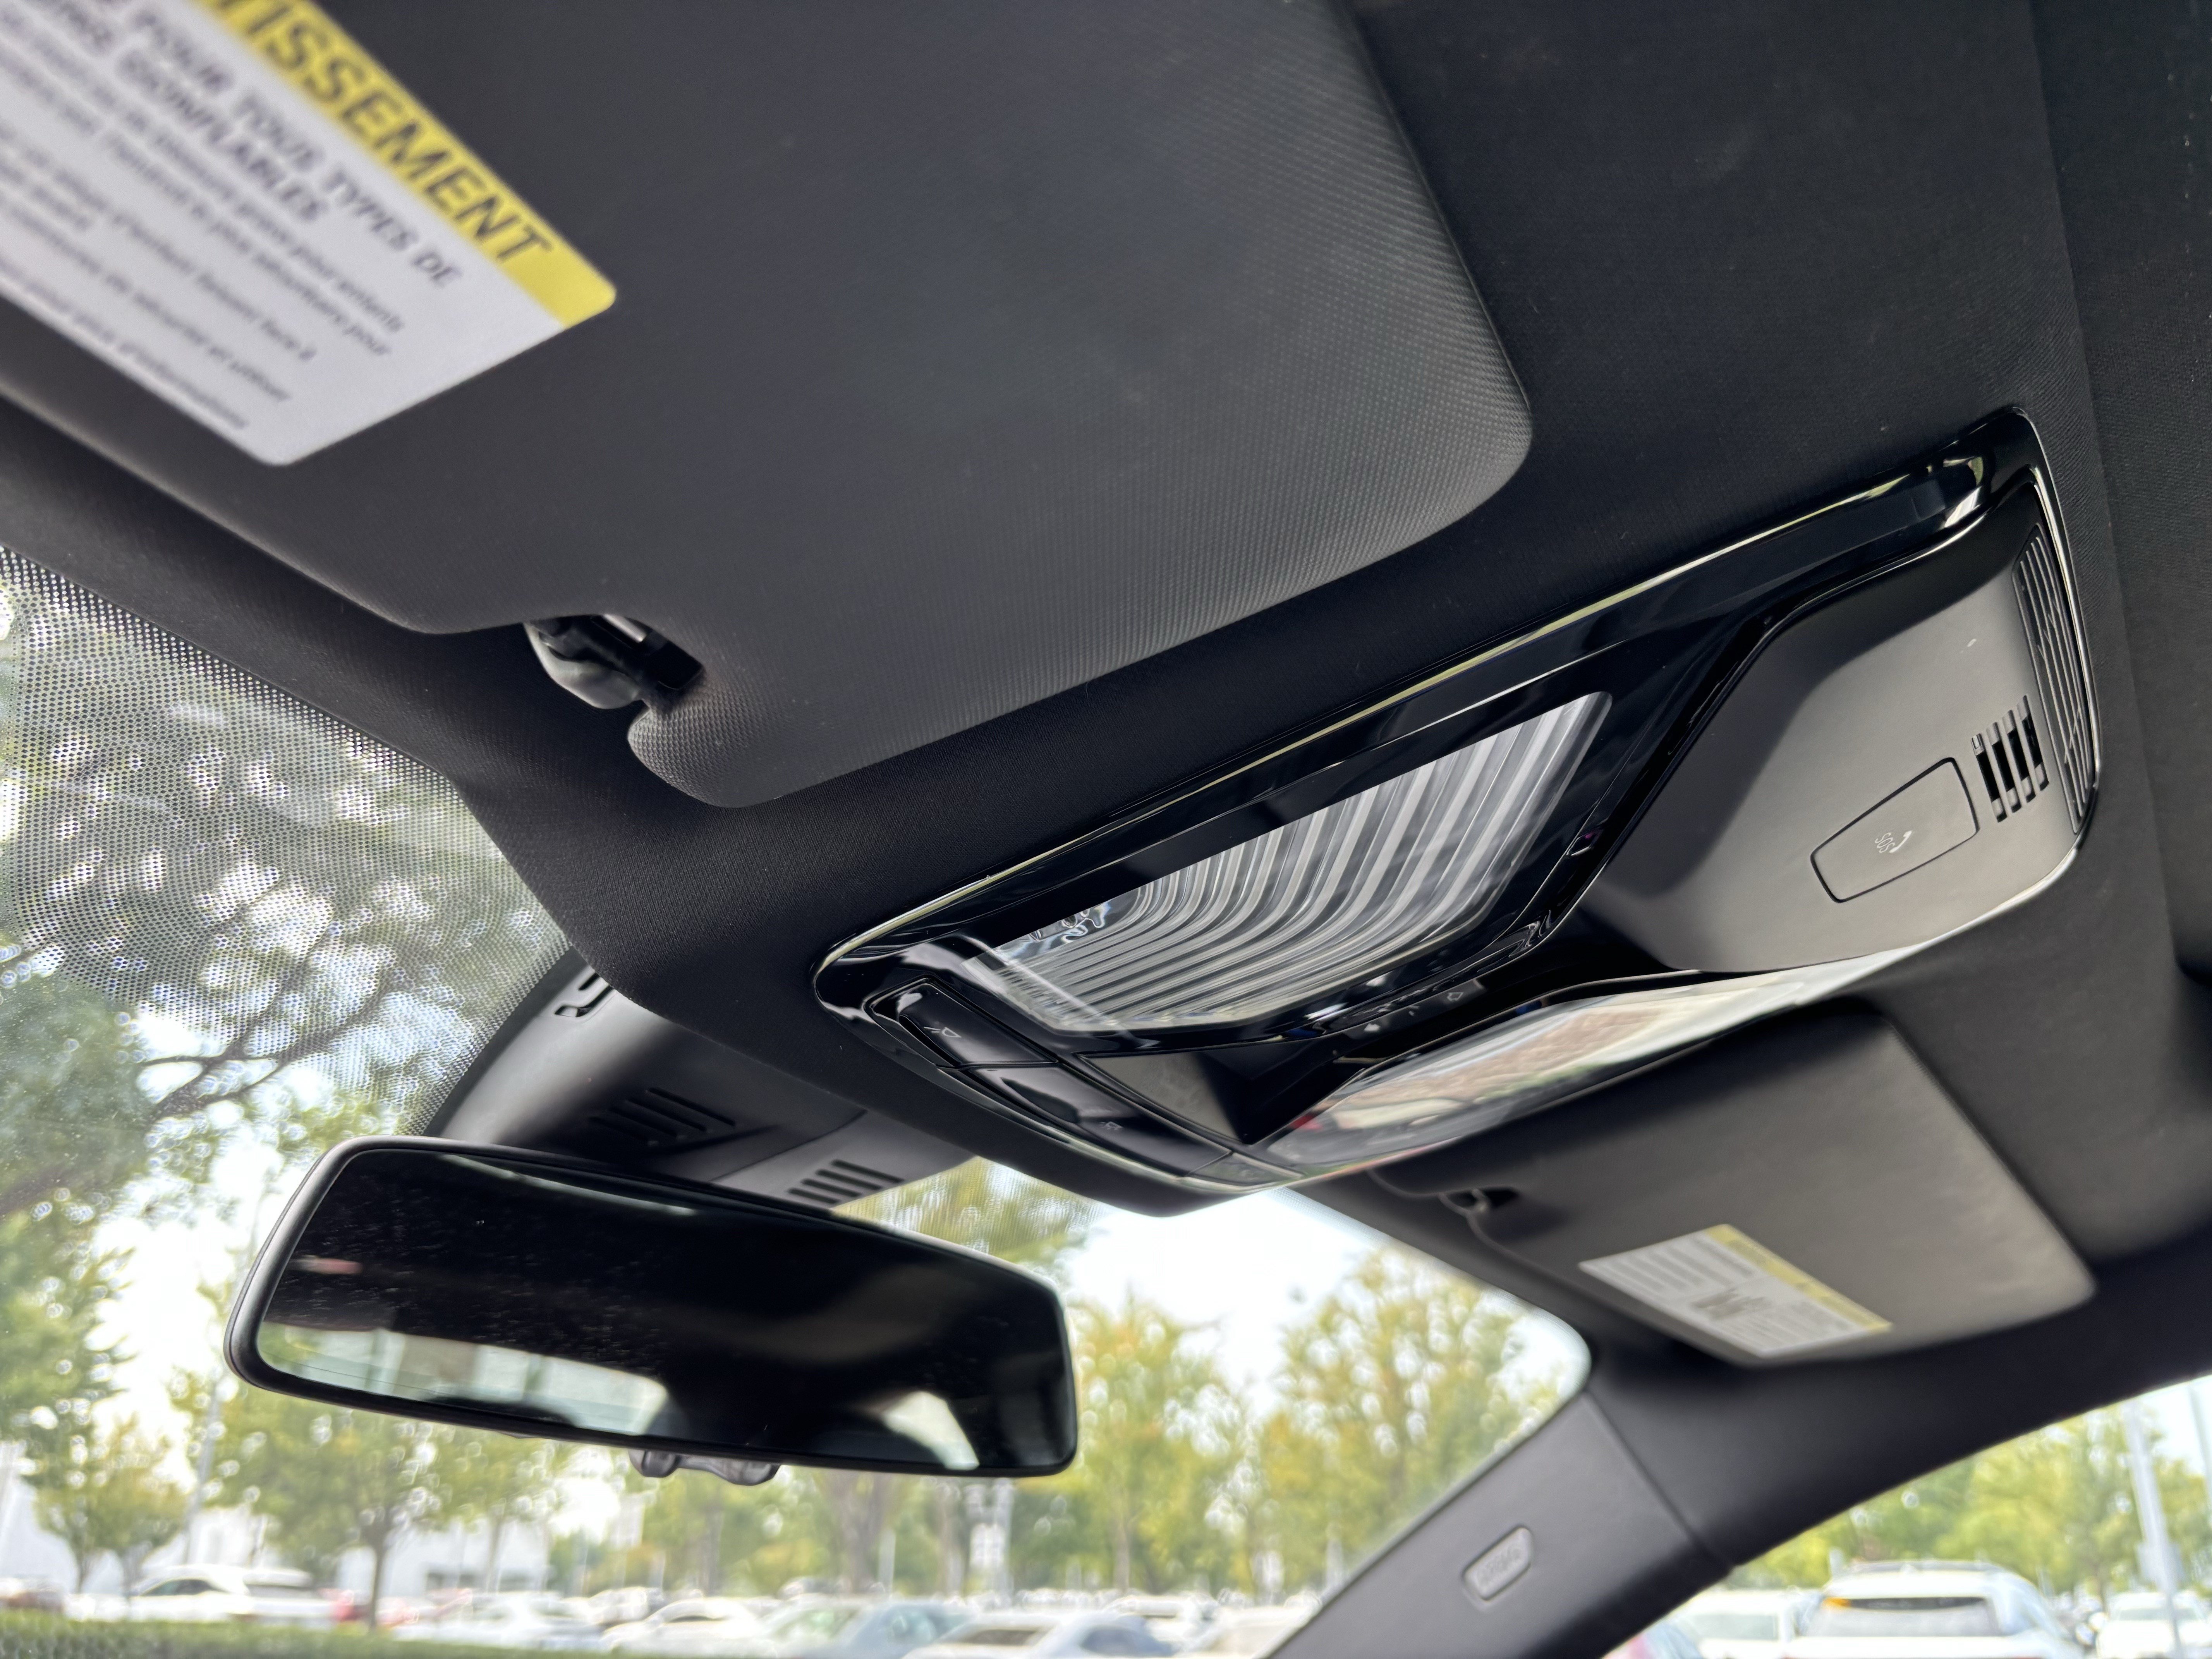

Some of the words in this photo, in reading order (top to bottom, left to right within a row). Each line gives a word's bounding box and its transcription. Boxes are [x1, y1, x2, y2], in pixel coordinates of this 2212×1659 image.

[323, 169, 416, 250] TYPES
[411, 249, 462, 287] DE
[1874, 832, 1895, 853] SOS
